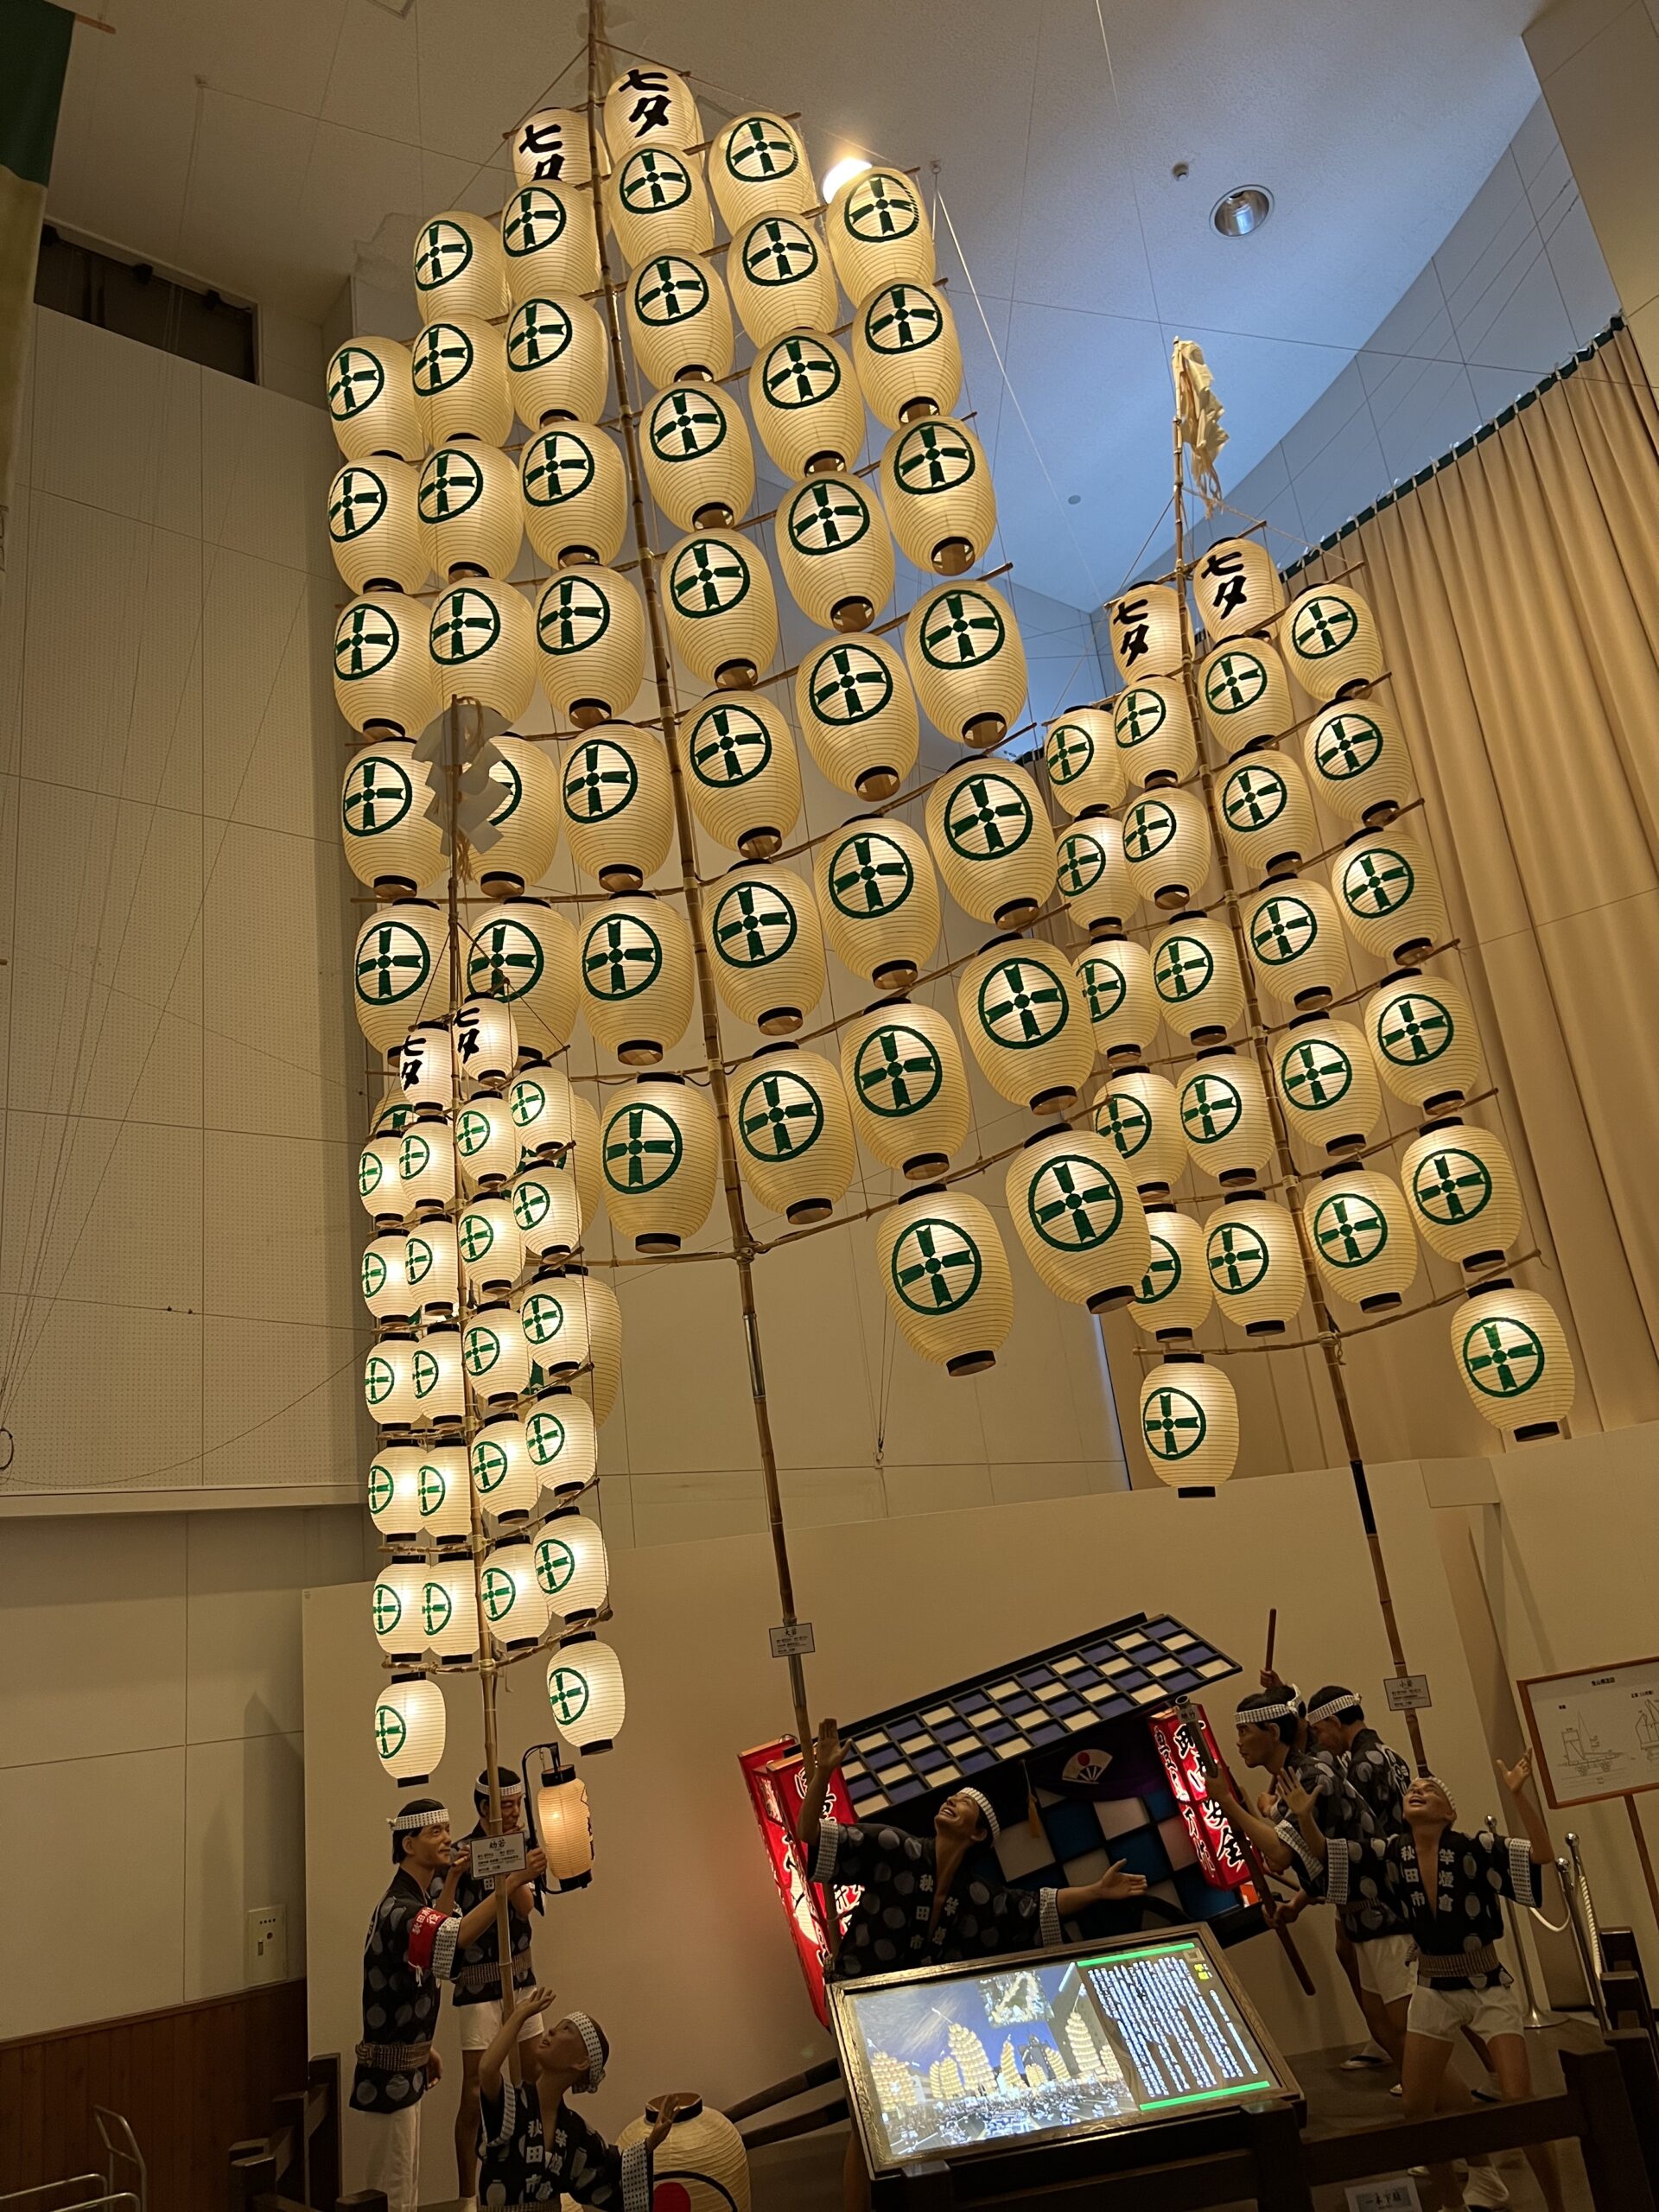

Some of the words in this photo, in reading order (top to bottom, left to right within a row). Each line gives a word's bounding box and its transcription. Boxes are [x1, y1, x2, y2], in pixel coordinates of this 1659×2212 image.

[618, 69, 672, 138] 七夕
[1201, 551, 1247, 620] 七夕
[1113, 599, 1149, 668] 七夕
[401, 1035, 427, 1090] 七夕
[454, 1007, 480, 1064] 七夕
[1401, 1845, 1425, 1907] 秋田市
[910, 1873, 934, 1949] 秋田市
[525, 2119, 543, 2193] 秋田市
